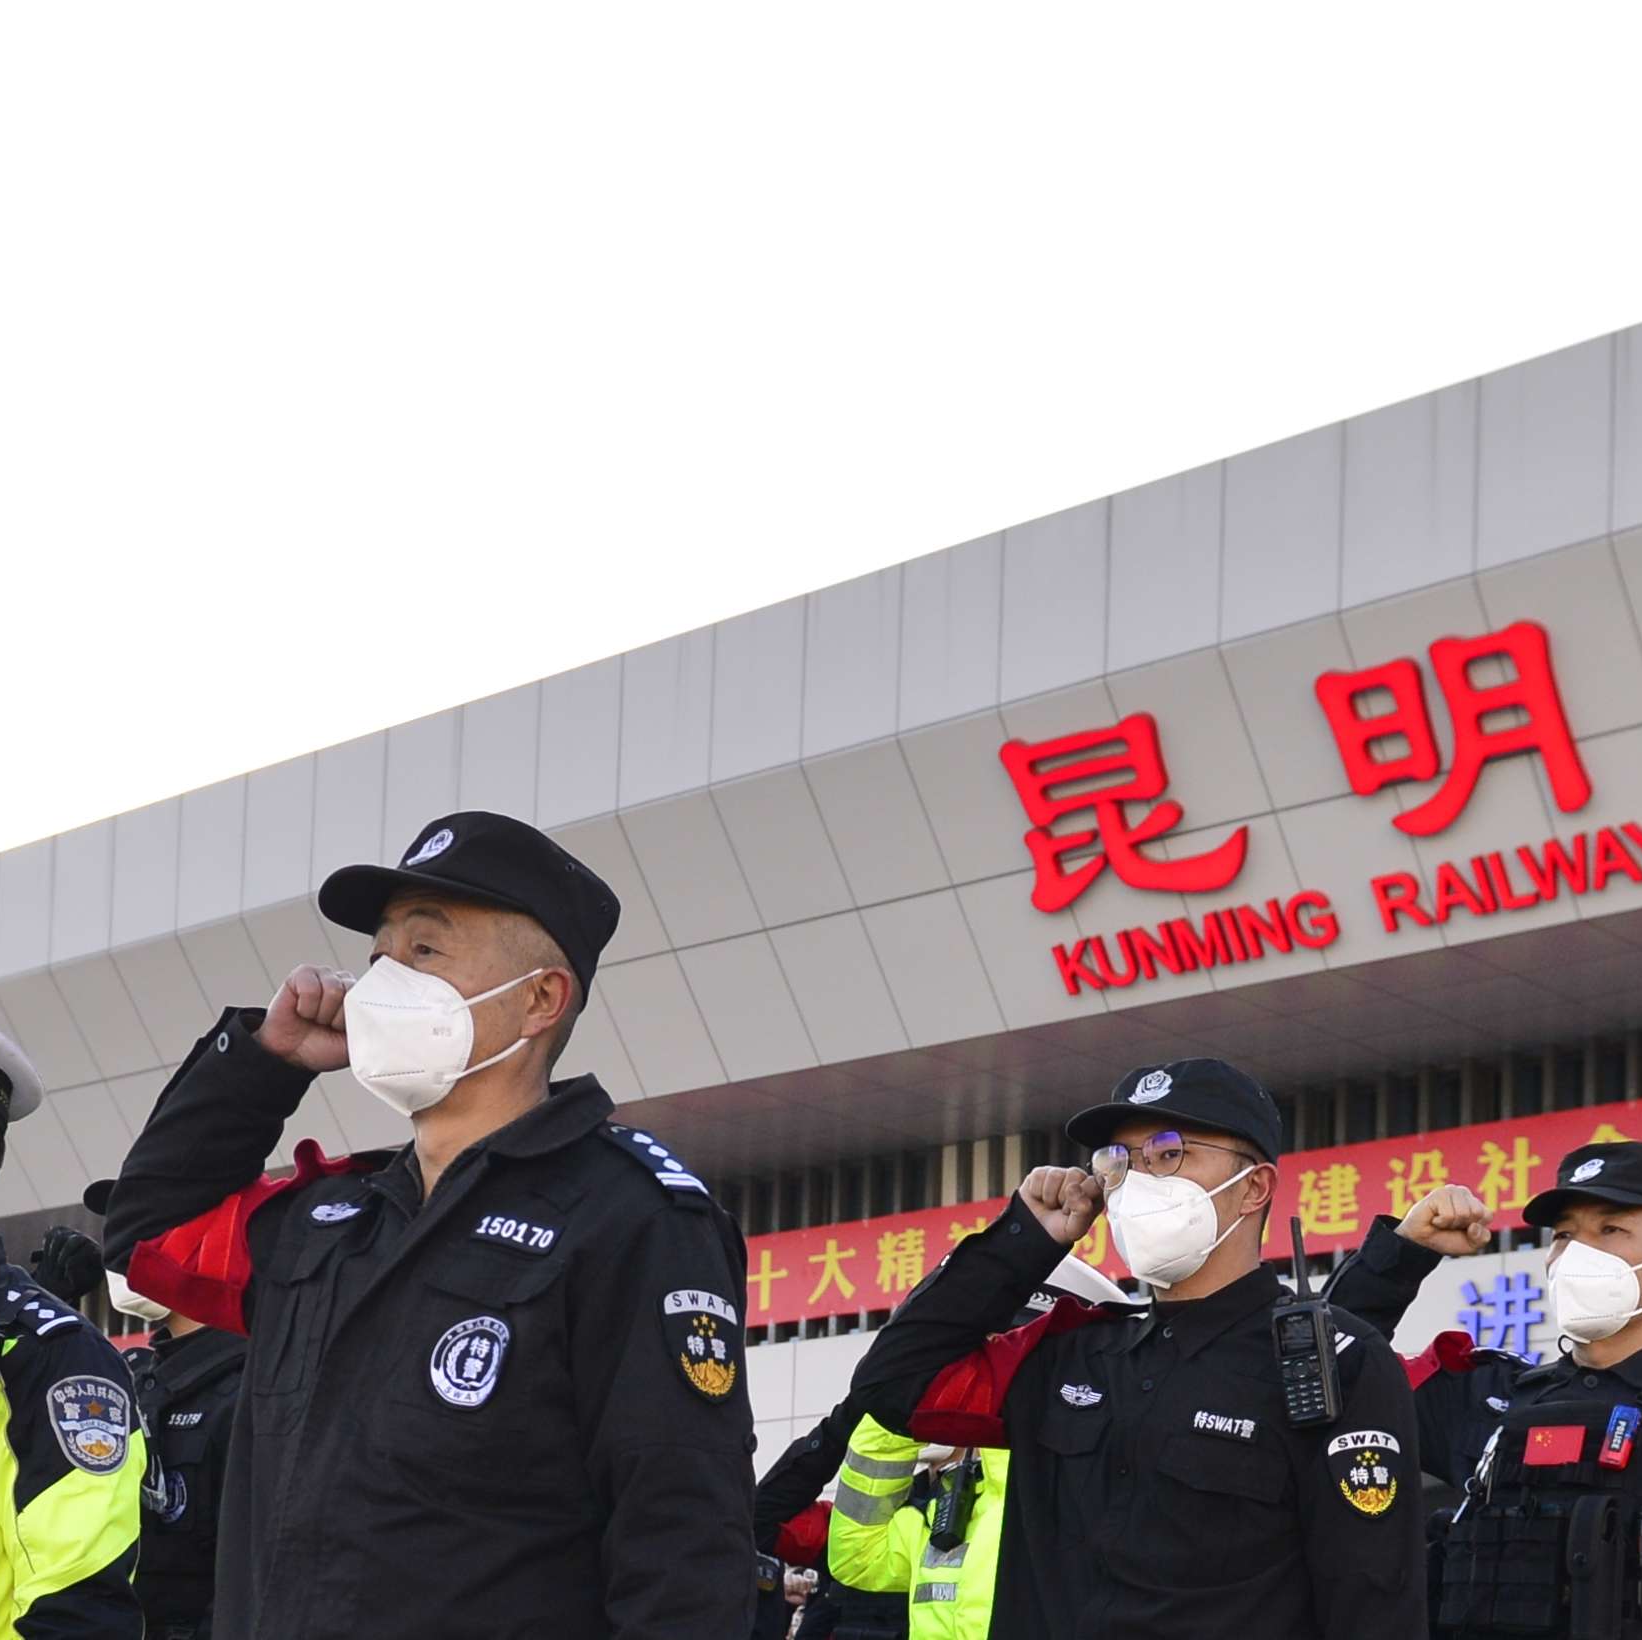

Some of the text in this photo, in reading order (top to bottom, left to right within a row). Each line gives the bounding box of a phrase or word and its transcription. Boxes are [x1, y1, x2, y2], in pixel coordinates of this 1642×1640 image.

[1051, 889, 1339, 996] KUNMING
[475, 1215, 555, 1249] 150170
[671, 1291, 730, 1315] SWAT
[462, 1335, 492, 1380] 特警
[686, 1334, 727, 1360] 特警
[442, 1383, 481, 1402] SWAT
[1193, 1410, 1256, 1439] 特SWAT警
[1610, 1419, 1627, 1450] POLICE
[1337, 1432, 1392, 1449] SWAT
[1349, 1465, 1389, 1485] 特警
